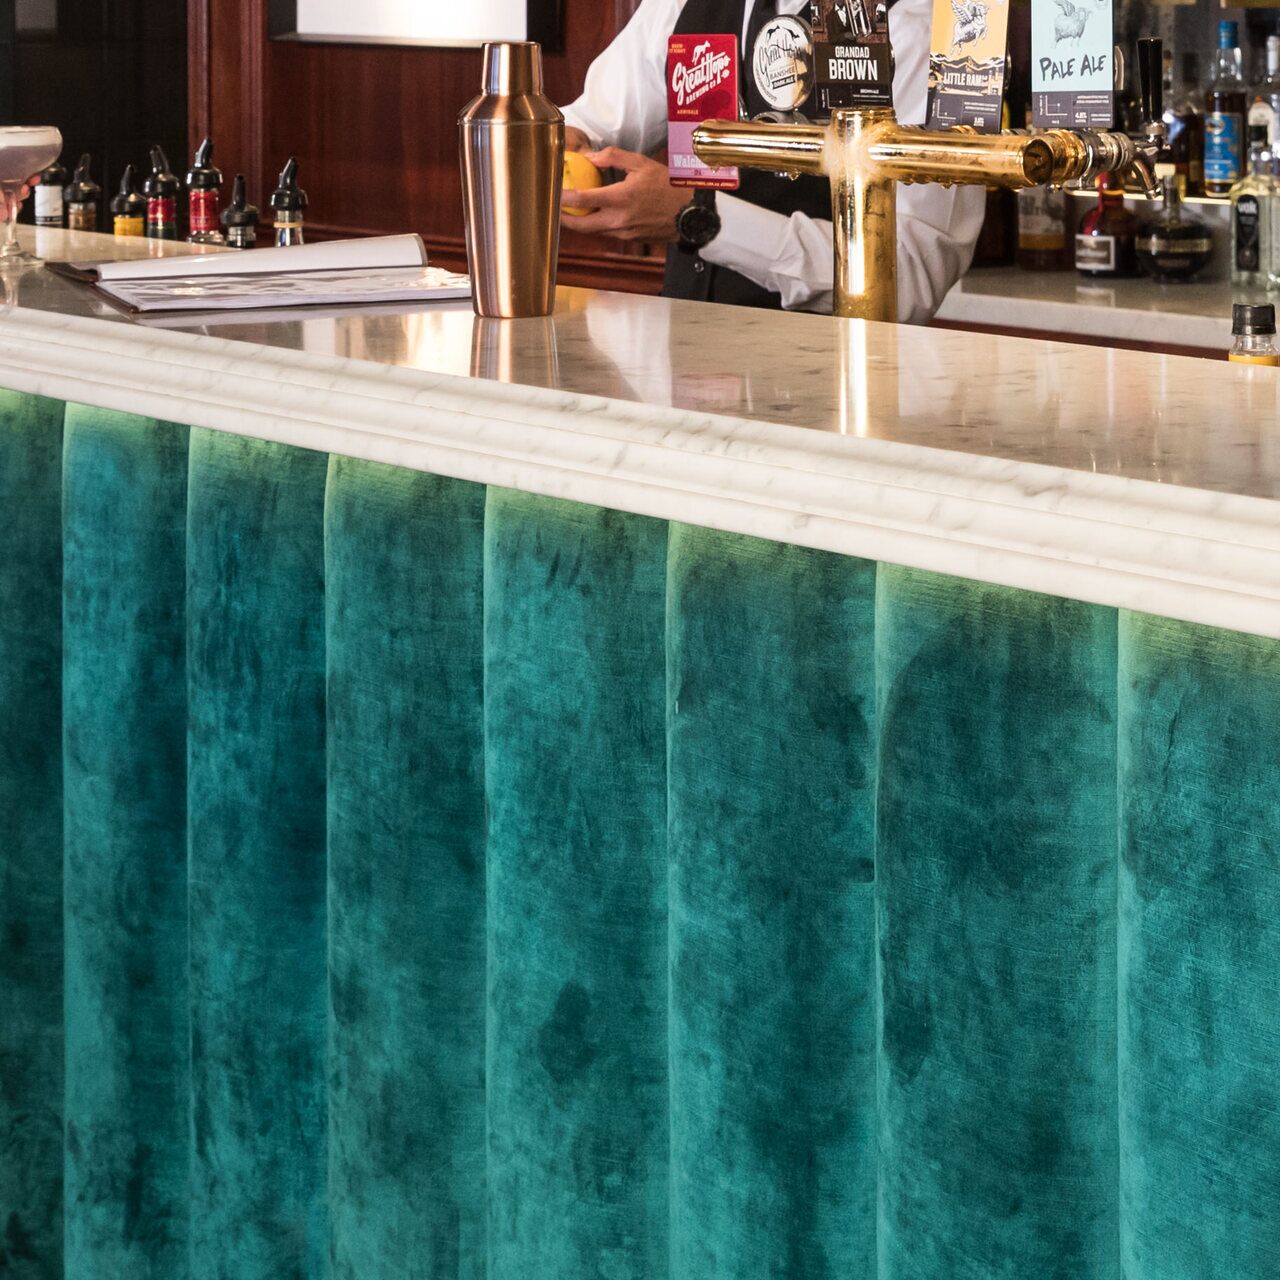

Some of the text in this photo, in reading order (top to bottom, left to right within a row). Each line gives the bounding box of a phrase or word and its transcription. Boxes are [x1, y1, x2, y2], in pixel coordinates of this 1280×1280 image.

[834, 46, 870, 58] GRANDAD
[828, 58, 878, 80] BROWN
[1039, 54, 1107, 81] PALE ALE
[943, 72, 966, 86] LITTLE
[673, 154, 708, 168] Walch
[1237, 200, 1258, 214] vok
